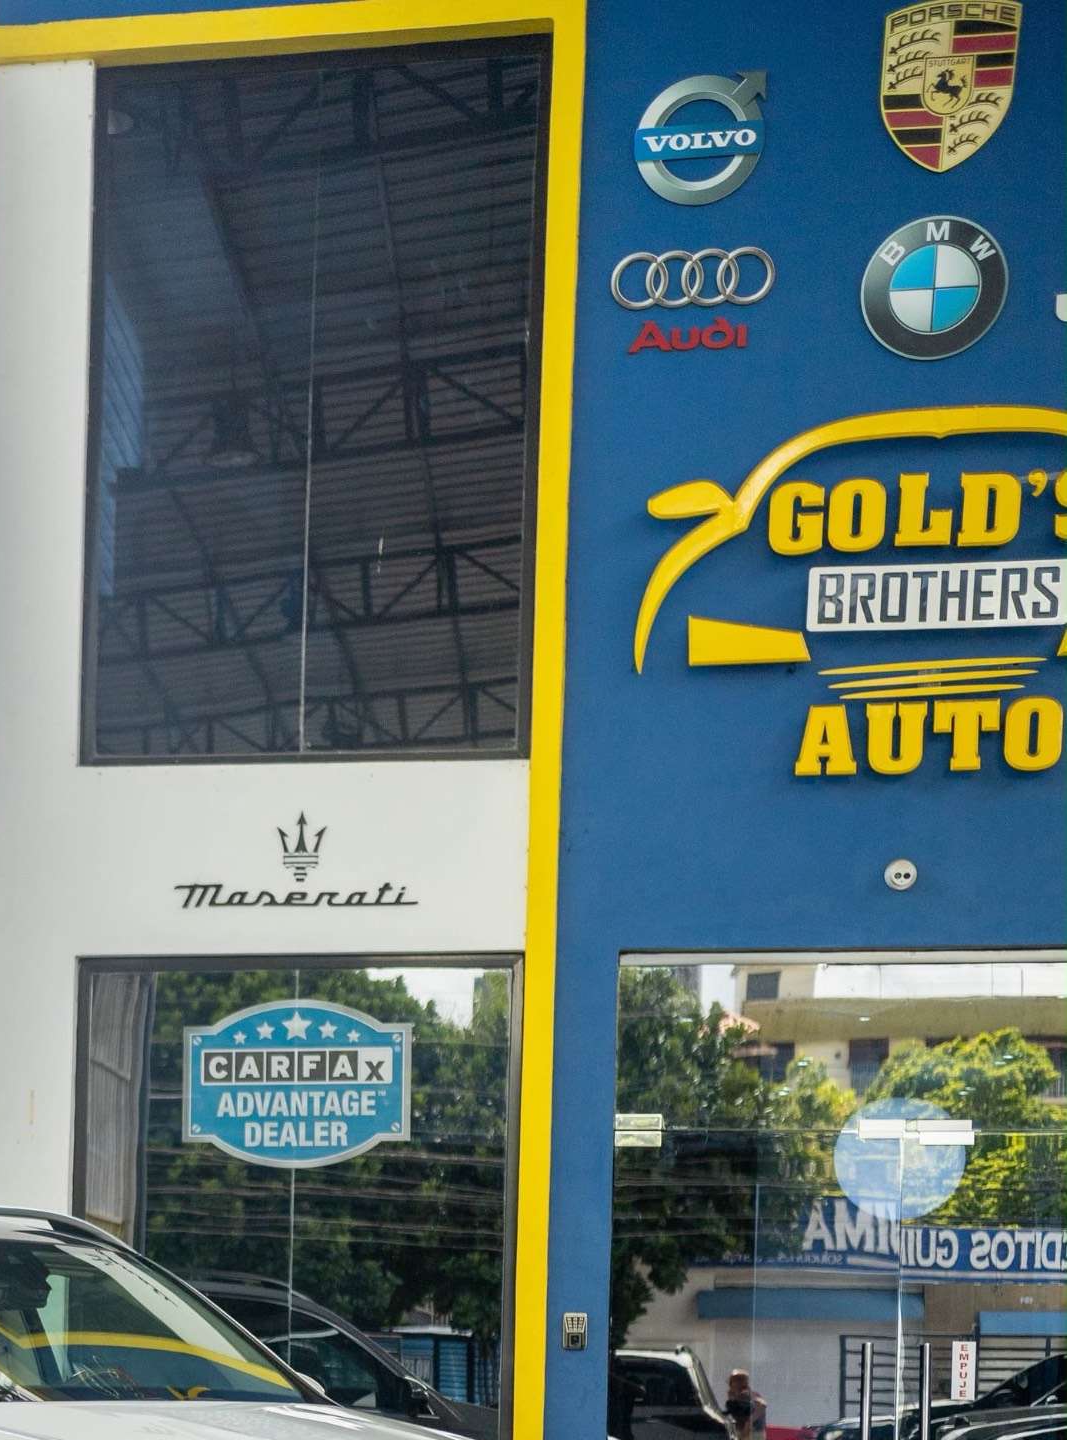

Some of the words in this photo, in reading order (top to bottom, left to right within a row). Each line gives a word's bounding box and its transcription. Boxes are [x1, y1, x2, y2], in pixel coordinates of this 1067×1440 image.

[890, 3, 1017, 34] PORSCHE
[644, 128, 757, 153] VOLVO
[878, 220, 996, 267] BMW
[629, 316, 748, 354] Audi
[768, 471, 1067, 556] GOLD'
[817, 566, 1060, 624] BROTHERS
[794, 694, 1064, 776] AUTO
[174, 882, 419, 909] Maserati
[208, 1054, 385, 1082] CARFAX
[216, 1089, 377, 1118] ADVANTAGE
[244, 1120, 349, 1148] DEALER
[958, 1343, 969, 1398] EMPUJE
